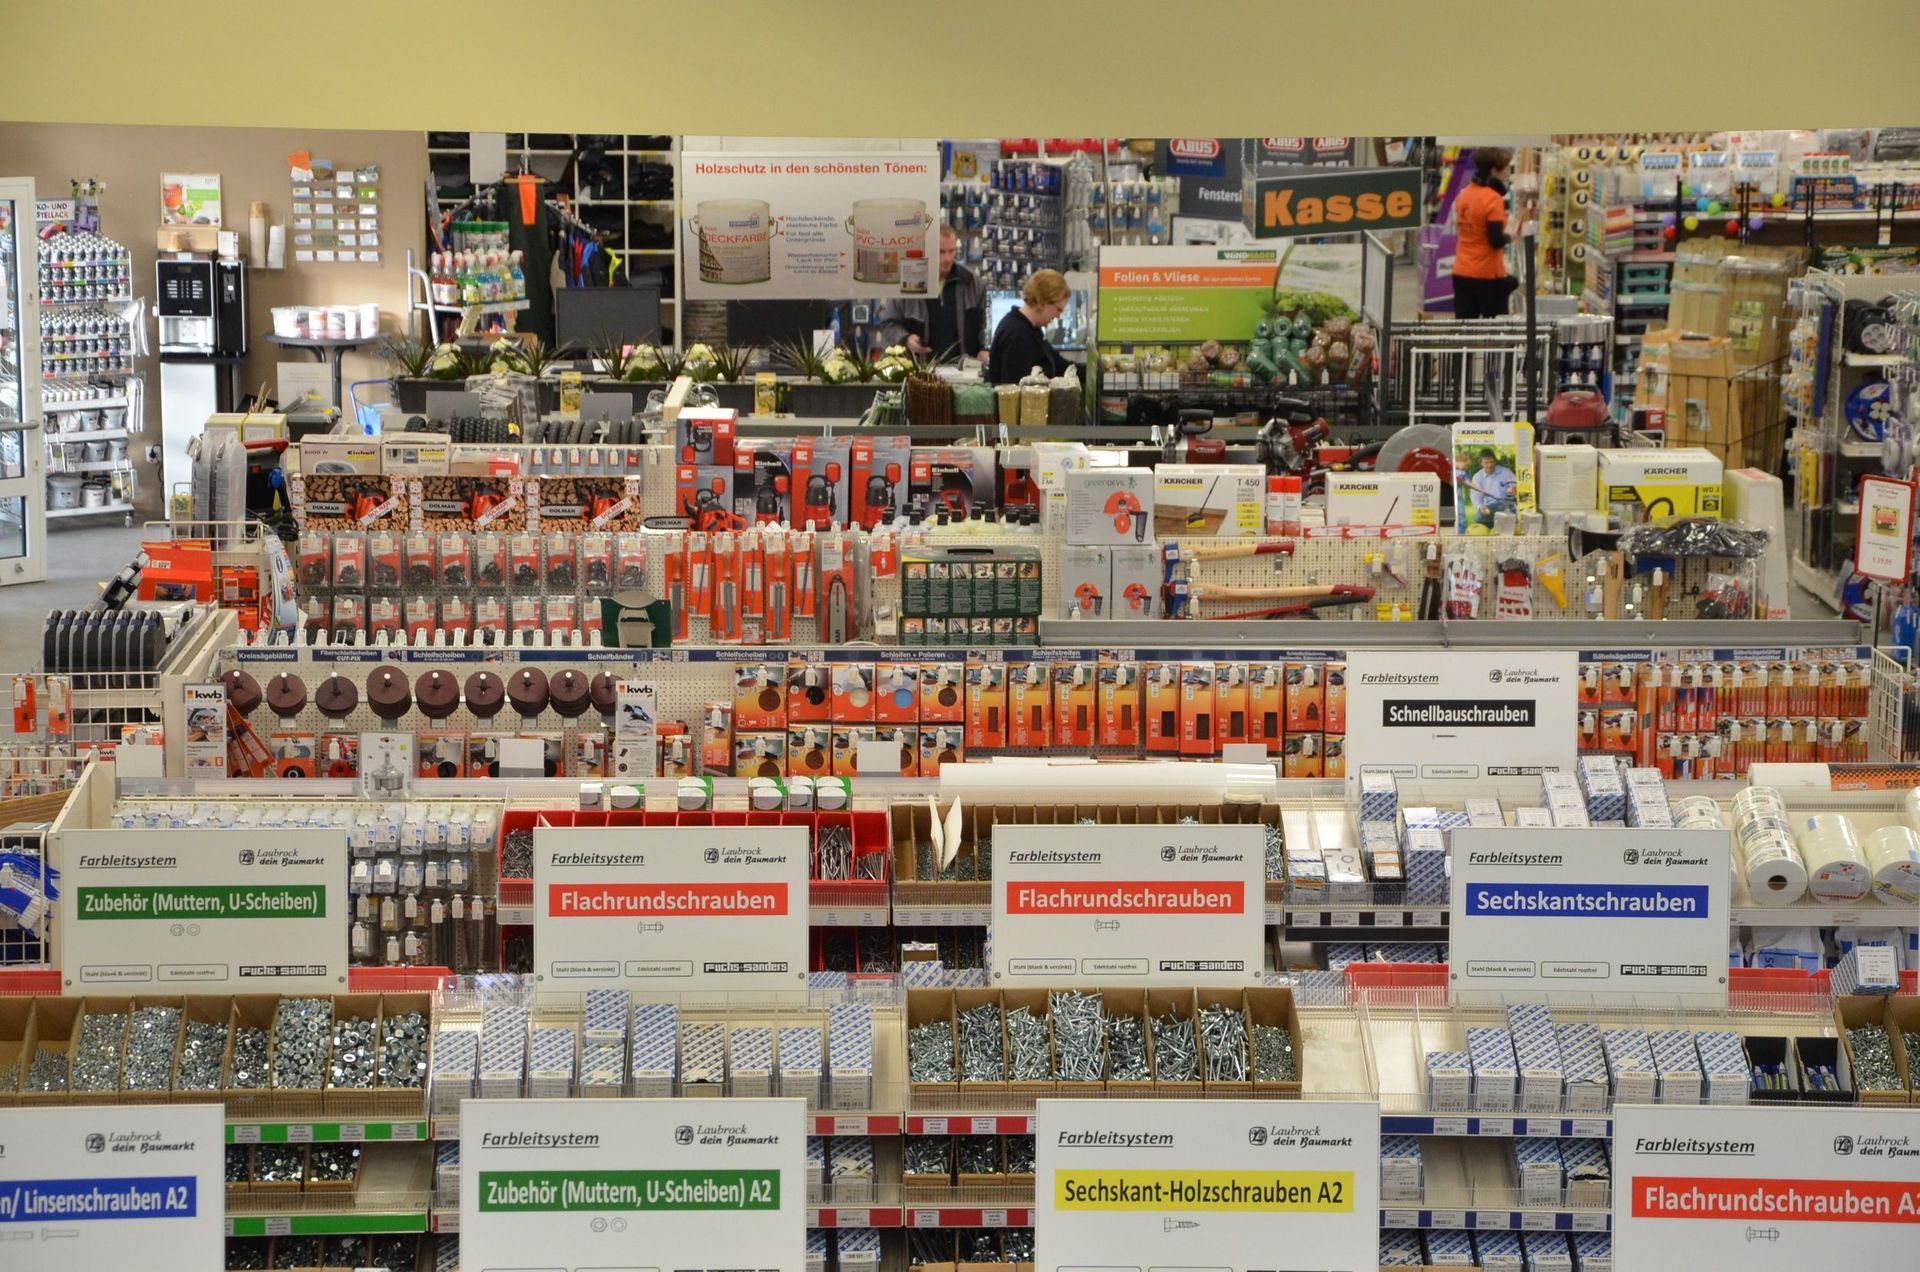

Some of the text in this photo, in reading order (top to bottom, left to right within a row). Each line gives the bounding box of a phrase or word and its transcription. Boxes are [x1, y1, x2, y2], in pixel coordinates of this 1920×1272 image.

[1176, 141, 1213, 154] ABUS
[1266, 138, 1299, 148] ABUS
[696, 162, 927, 174] Holzschutz in den schönsten Tönen:
[1199, 187, 1242, 203] Fenstersi
[51, 203, 68, 211] UND
[1264, 189, 1412, 228] Kasse
[704, 233, 768, 244] DECKFARBE
[856, 235, 915, 246] PVC-LACK
[1113, 272, 1150, 283] Folien
[1152, 272, 1161, 283] &
[1164, 271, 1200, 283] Vliese
[511, 484, 521, 493] 3+
[626, 484, 637, 493] 3+
[1244, 479, 1260, 487] 450
[1412, 484, 1434, 493] T 350
[312, 504, 340, 512] DOLMAR
[367, 500, 392, 519] DOLMAR
[485, 501, 510, 519] DOLMAR
[601, 501, 625, 520] DOLMAR
[238, 652, 295, 661] Kreissägeblätter
[588, 653, 634, 661] Schleifbänder
[1361, 673, 1439, 685] Farbleitsystem
[1504, 669, 1538, 677] Laubrock
[1523, 676, 1560, 684] Baumarkt
[195, 690, 223, 700] kwb
[627, 685, 653, 695] kwb
[1389, 704, 1529, 723] Schnellbauschrauben
[257, 848, 298, 858] Laubrock
[722, 847, 762, 856] Laubrock
[1178, 845, 1218, 854] Laubrock
[1642, 848, 1682, 858] Laubrock
[80, 855, 177, 868] Farbleitsystem
[259, 857, 325, 867] dein Baumarkt
[551, 853, 644, 865] Farbleitsystem
[724, 855, 787, 865] dein Baumarkt
[1009, 851, 1101, 863] Farbleitsystem
[1180, 853, 1244, 863] dein Baumarkt
[1469, 852, 1563, 865] Farbleitsystem
[1644, 857, 1708, 866] dein Baumarkt
[85, 890, 318, 915] Zubehör (Muttern, U-Scheiben)
[561, 890, 776, 911] Flachrundschrauben
[1019, 888, 1232, 908] Flachrundschrauben
[1477, 890, 1696, 912] Sechskantschrauben
[697, 1124, 748, 1135] Laubrock
[1271, 1126, 1320, 1136] Laubrock
[109, 1132, 162, 1142] Laubrock
[482, 1132, 600, 1148] Farbleitsystem
[700, 1135, 779, 1147] dein Baumarkt
[1058, 1131, 1174, 1147] Farbleitsystem
[1273, 1136, 1352, 1148] dein Baumarkt
[1857, 1135, 1910, 1146] Laubrock
[112, 1142, 195, 1154] dein Baumarkt
[1635, 1138, 1755, 1155] Farbleitsystem
[1860, 1146, 1920, 1158] dein Baum
[487, 1178, 772, 1209] Zubehör (Muttern, U-Scheiben) A2
[1064, 1178, 1343, 1204] Sechskant-Holzschrauben A2
[24, 1186, 162, 1214] Linsenschrauben
[165, 1185, 188, 1210] A2
[1645, 1186, 1890, 1215] Flachrundschrauben
